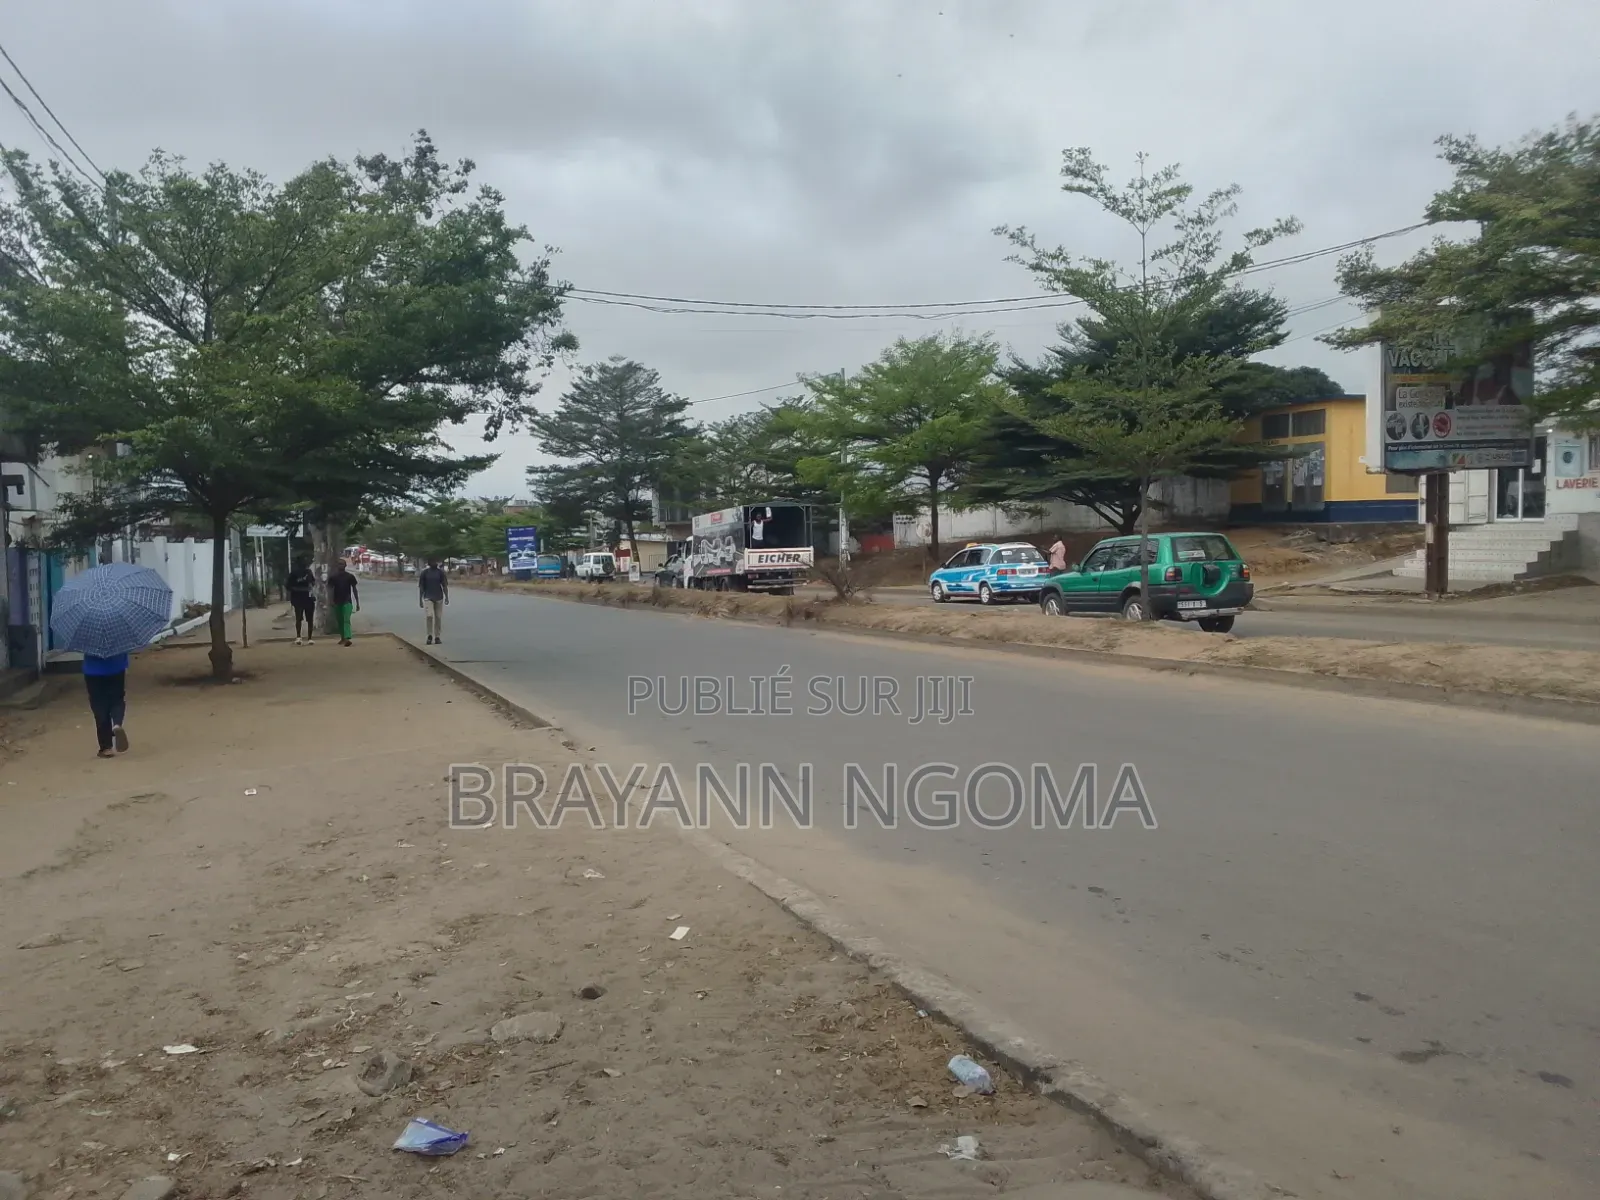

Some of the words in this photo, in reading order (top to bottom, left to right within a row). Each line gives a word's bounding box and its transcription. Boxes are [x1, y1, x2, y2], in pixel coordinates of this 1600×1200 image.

[1398, 388, 1408, 399] La
[1555, 477, 1599, 490] LAVERIE
[757, 553, 801, 564] EICHER
